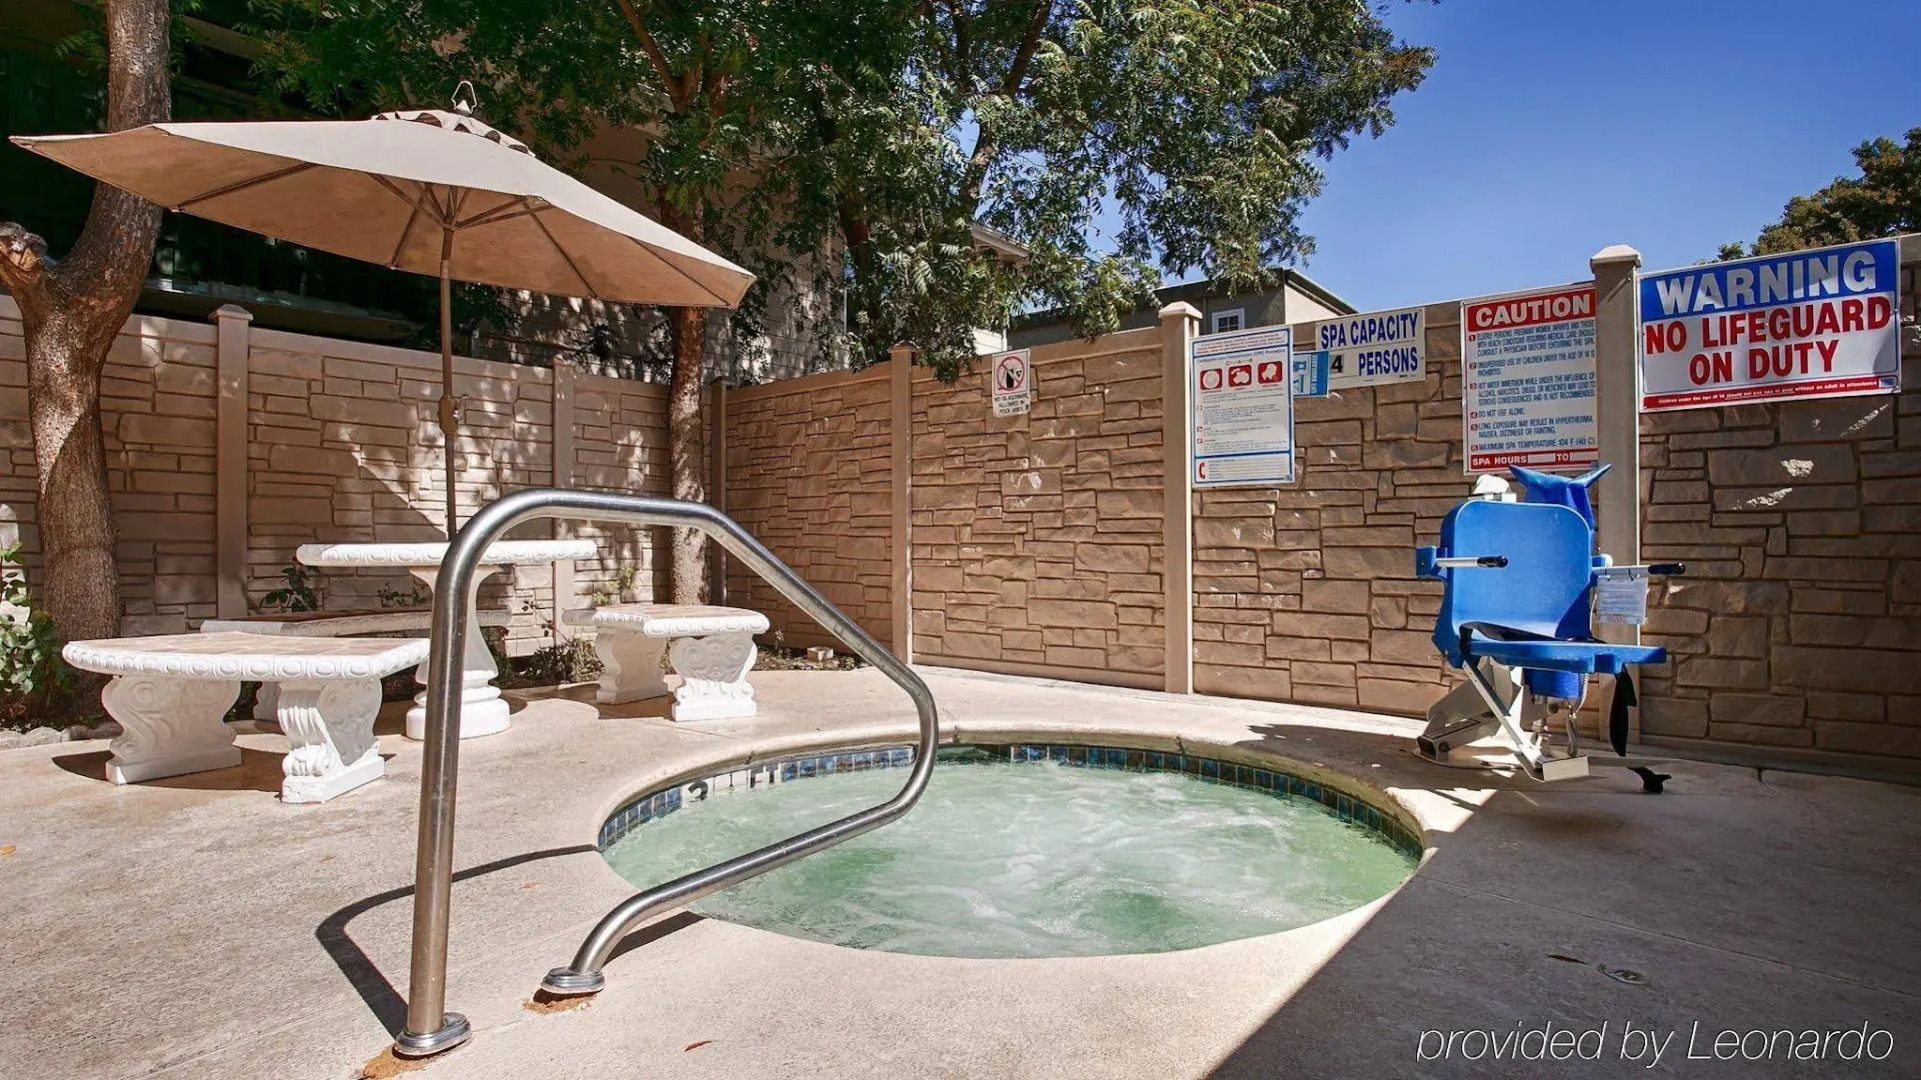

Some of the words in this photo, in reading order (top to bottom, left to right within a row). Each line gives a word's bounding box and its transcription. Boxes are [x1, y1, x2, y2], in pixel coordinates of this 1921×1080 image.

[1656, 251, 1876, 316] WARNING
[1476, 294, 1590, 327] CAUTION
[1321, 323, 1346, 349] SPA
[1350, 312, 1418, 344] CAPACITY
[1646, 321, 1686, 354] NO
[1702, 296, 1891, 348] LIFEGUARD
[1478, 348, 1498, 356] CONSULT
[1504, 344, 1528, 354] PHYSICIAN
[1528, 342, 1546, 350] BEFORE
[1548, 340, 1572, 349] ENTERING
[1330, 355, 1343, 372] 4
[1358, 346, 1418, 376] PERSONS
[1478, 360, 1506, 368] UNSUPERVISED
[1522, 356, 1542, 364] CHILDREN
[1544, 354, 1557, 362] UNDER
[1690, 352, 1732, 385] ON
[1749, 340, 1838, 379] DUTY
[1487, 380, 1500, 388] WATER
[1501, 379, 1524, 387] IMMERSION
[1540, 376, 1554, 384] UNDER
[1564, 372, 1588, 382] INFLUENCE
[1588, 372, 1594, 380] OF
[1544, 382, 1566, 392] MEDICINES
[1578, 381, 1588, 389] LEAD
[1478, 398, 1496, 406] SERIOUS
[1498, 395, 1532, 404] CONSEQUENCES
[1534, 393, 1542, 401] AND
[1550, 392, 1558, 400] NOT
[1497, 408, 1508, 416] USE
[1492, 420, 1518, 429] EXPOSURE
[1518, 420, 1528, 428] MAY
[1530, 418, 1548, 426] RESULT
[1549, 417, 1554, 425] IN
[1500, 428, 1524, 437] DIZZINESS
[1524, 428, 1532, 436] OR
[1479, 442, 1504, 450] MAXIMUM
[1505, 442, 1516, 450] SPA
[1518, 438, 1556, 448] TEMPERATURE
[1558, 438, 1568, 446] 104
[1472, 458, 1491, 466] SPA
[1494, 454, 1527, 464] HOURS
[1556, 453, 1569, 462] TO
